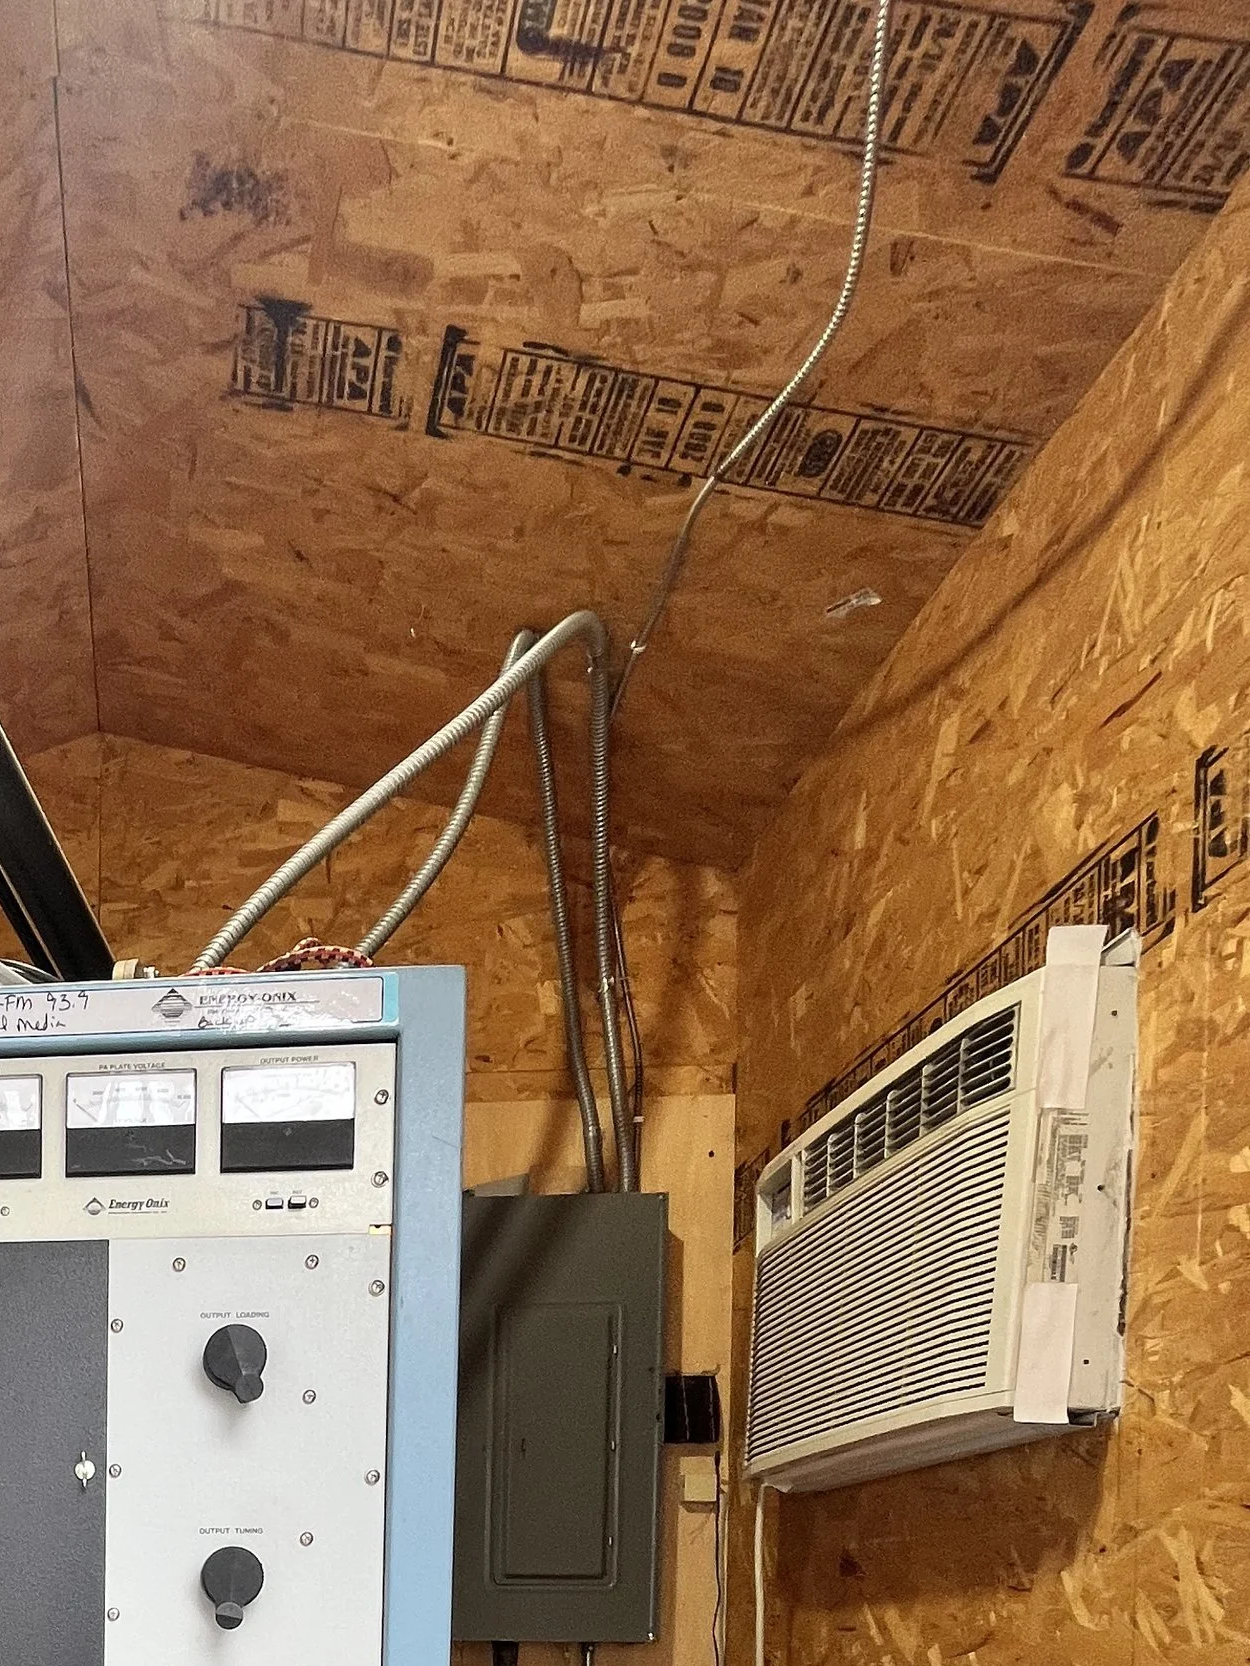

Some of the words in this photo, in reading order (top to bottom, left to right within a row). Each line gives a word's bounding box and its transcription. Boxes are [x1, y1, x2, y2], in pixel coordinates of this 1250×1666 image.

[47, 990, 90, 1011] 93.9
[17, 1012, 67, 1032] Media
[260, 1057, 289, 1065] OUTPUT
[291, 1055, 319, 1063] POWER
[133, 1062, 166, 1070] VOLTAGE
[108, 1199, 144, 1211] Energy
[145, 1197, 170, 1208] Onix
[235, 1311, 270, 1319] LOADING
[199, 1527, 230, 1535] OUTPUT
[235, 1527, 264, 1535] TUNING
